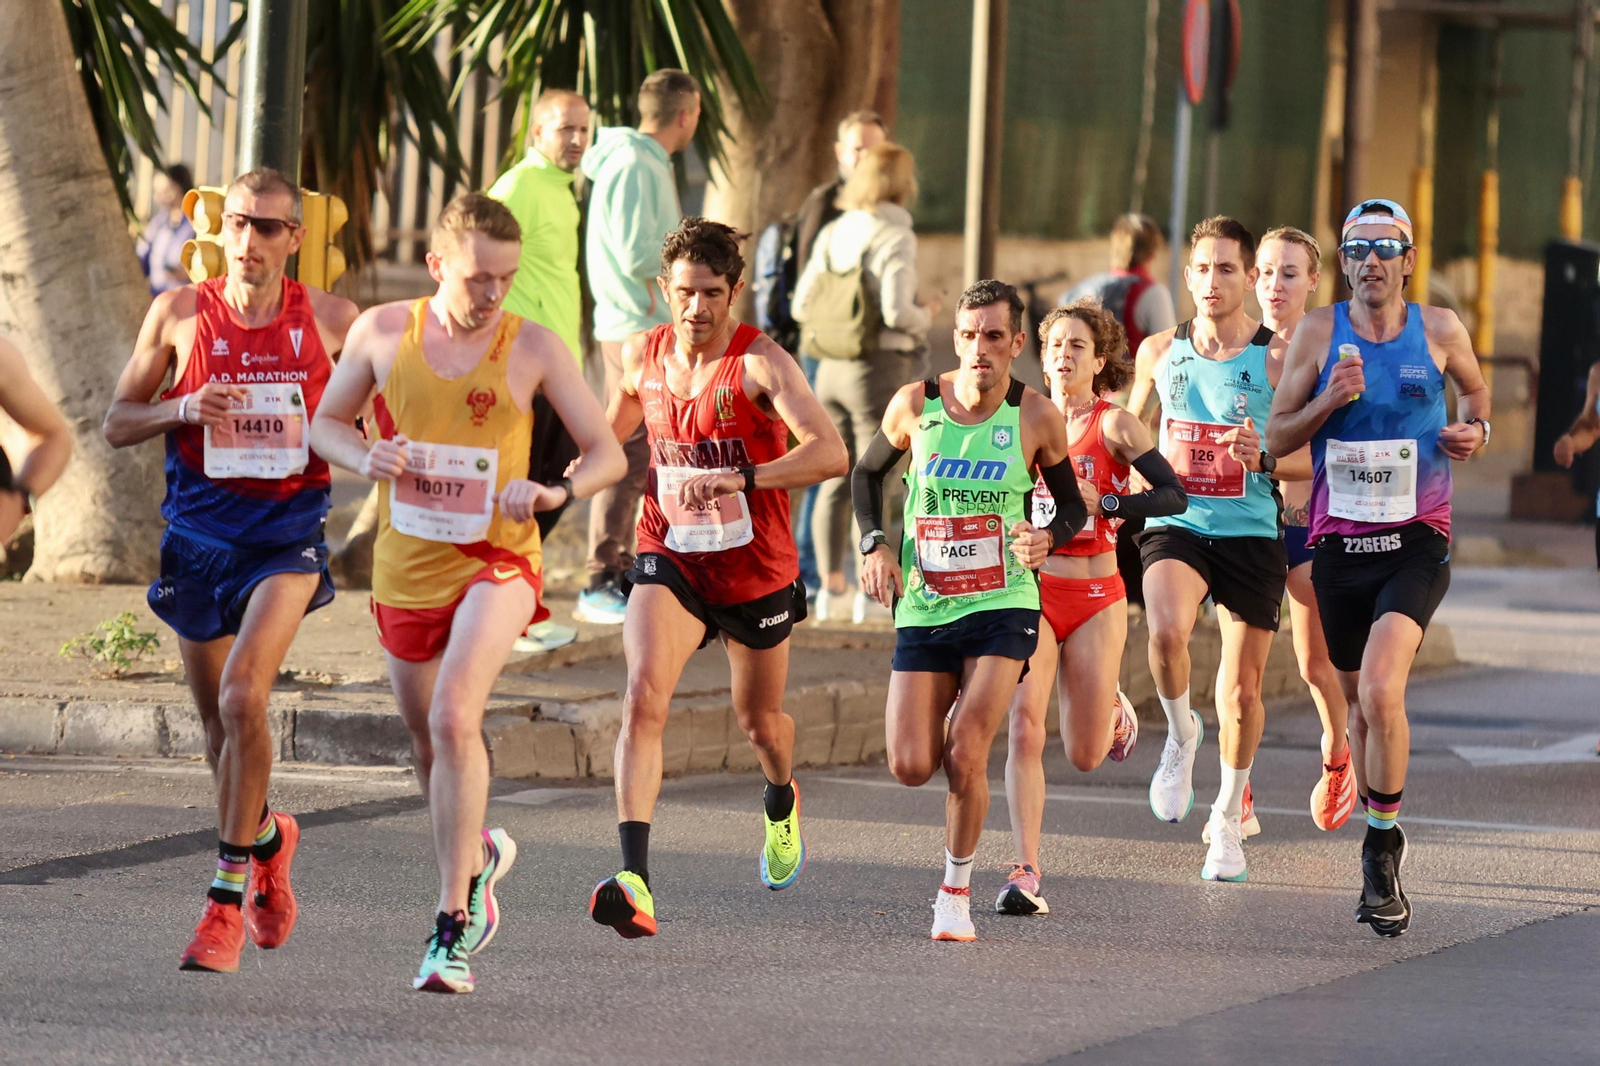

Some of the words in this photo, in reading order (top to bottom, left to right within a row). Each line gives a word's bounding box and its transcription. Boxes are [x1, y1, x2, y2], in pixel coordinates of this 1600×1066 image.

[209, 373, 233, 383] A.D.
[237, 371, 308, 383] MARATHON
[234, 419, 284, 433] 14410
[1190, 449, 1215, 462] 126
[1350, 470, 1393, 484] 14607
[414, 478, 465, 497] 10017
[942, 488, 1010, 503] PREVENT
[956, 501, 1009, 515] SPRAIN
[962, 523, 979, 531] 42K
[1343, 533, 1402, 553] 226ERS
[940, 544, 977, 558] PACE
[759, 610, 789, 629] Joma
